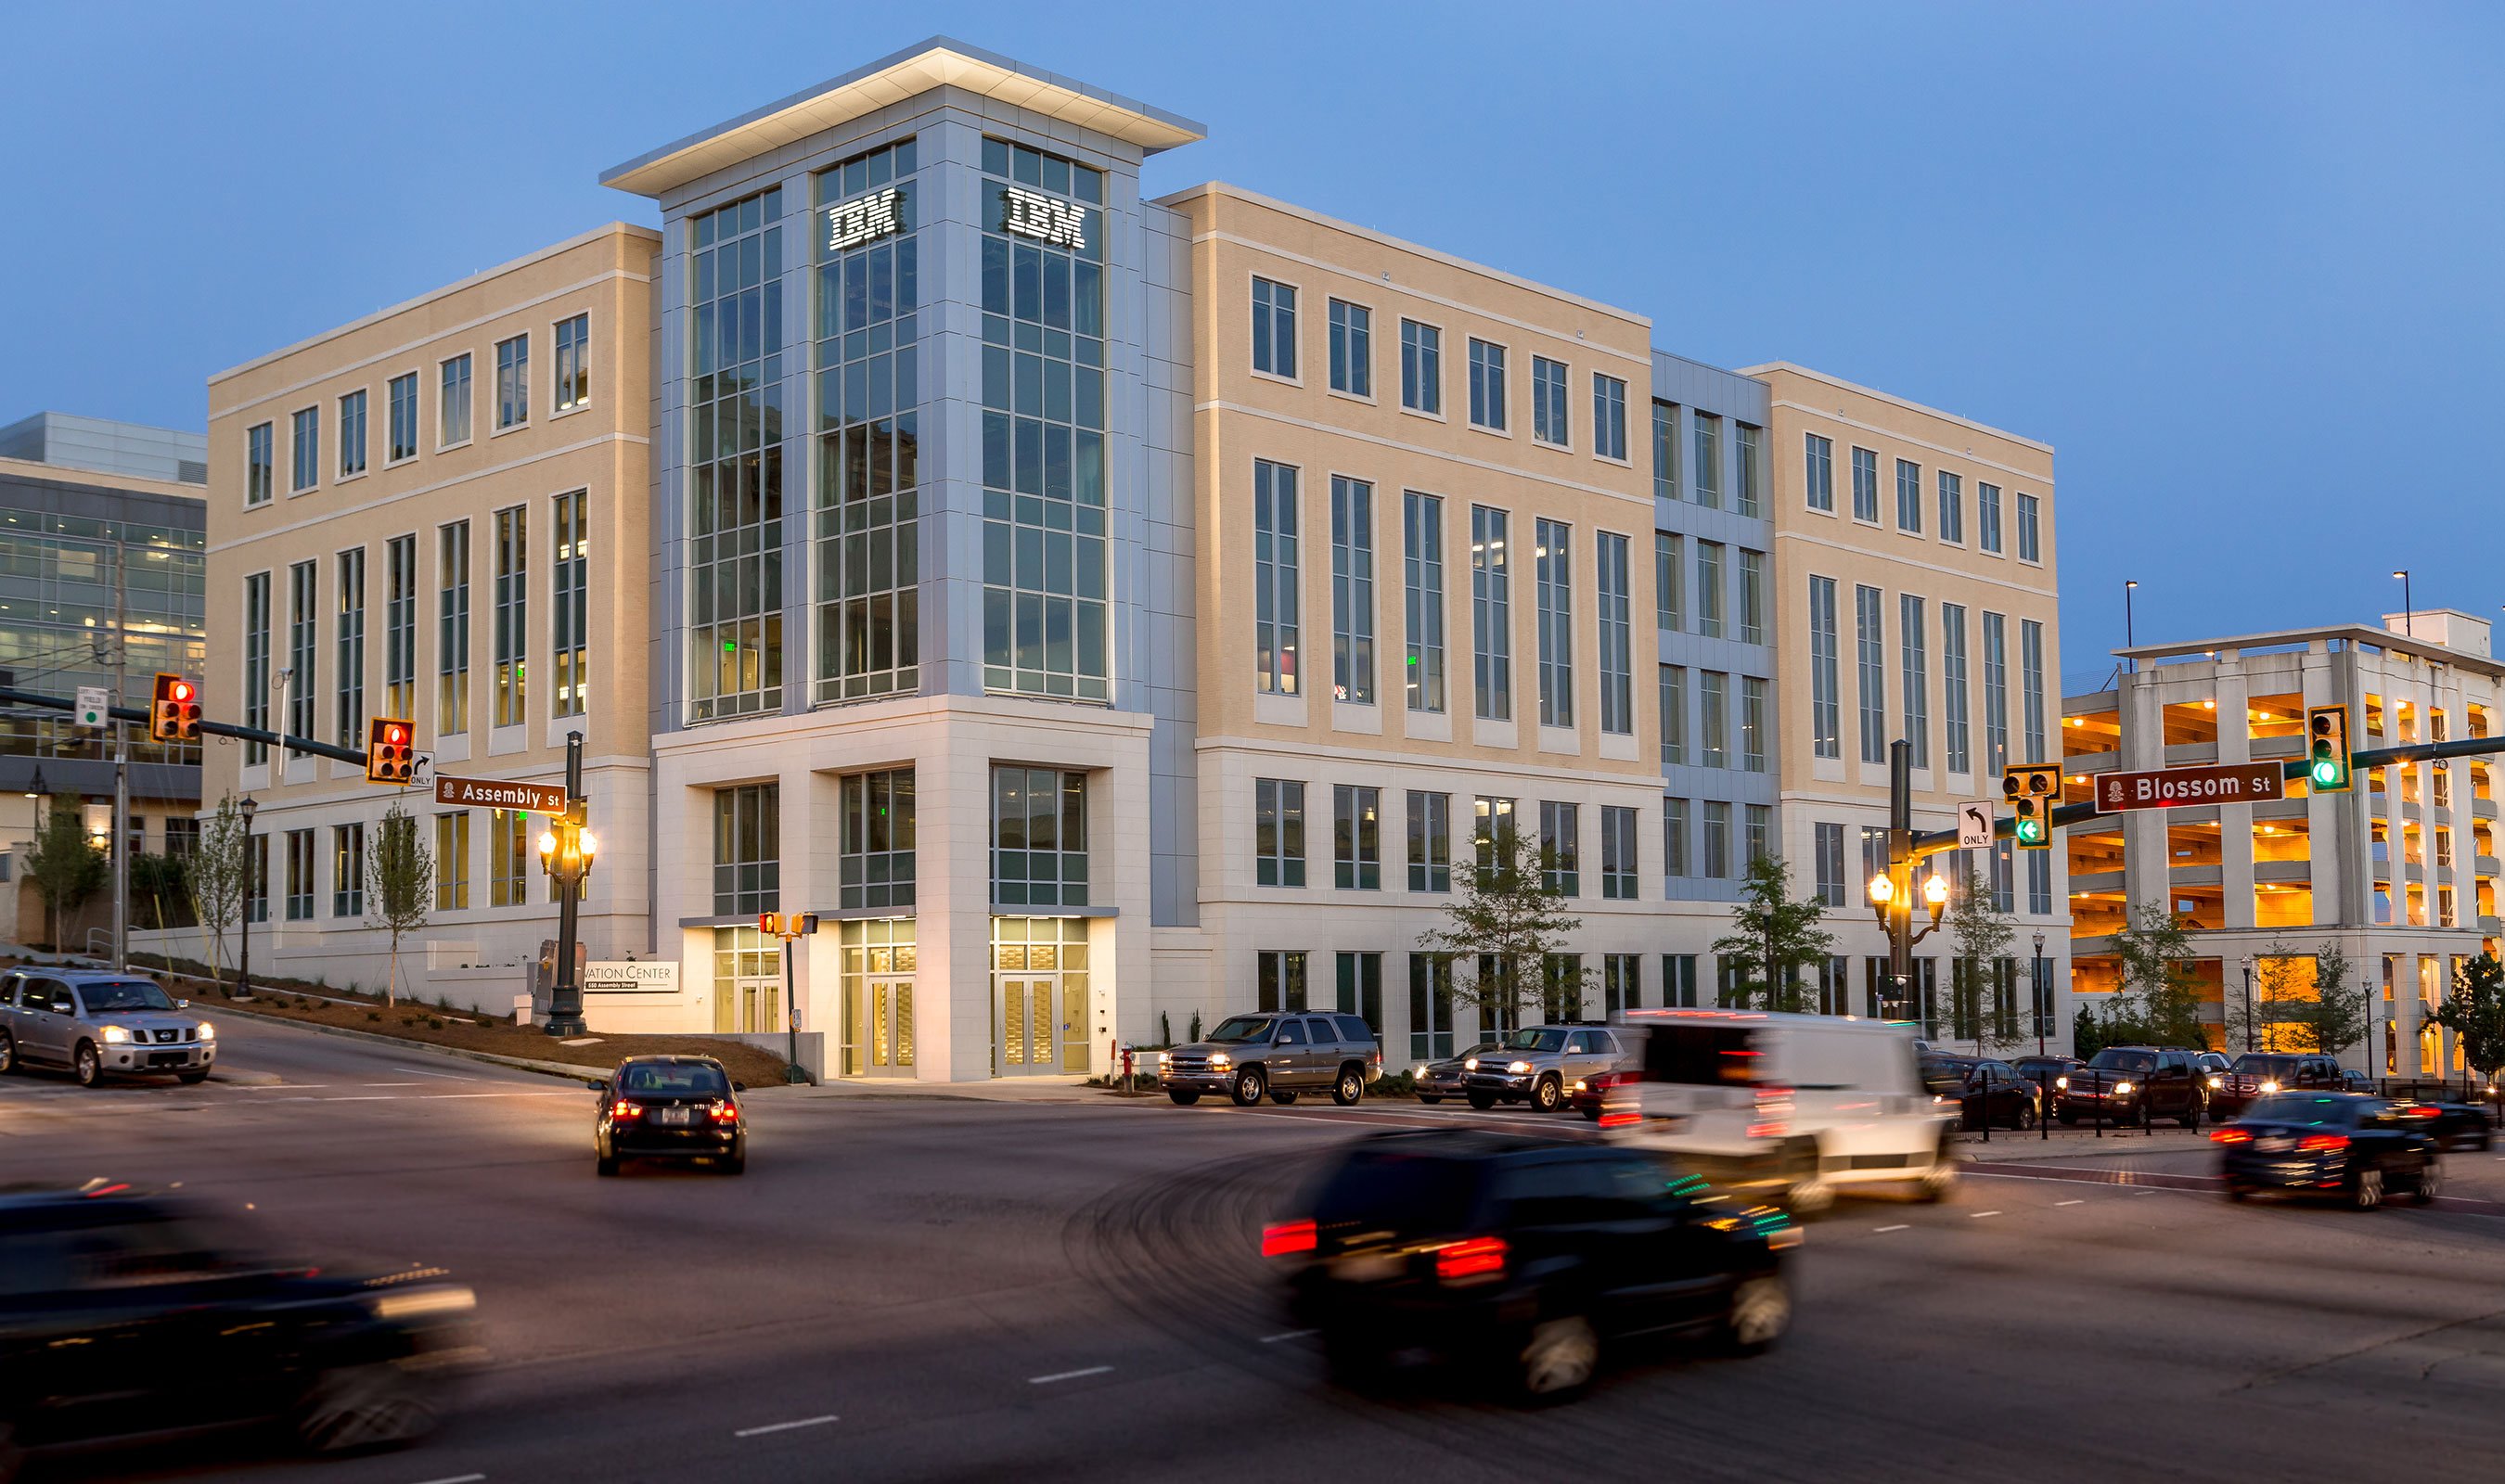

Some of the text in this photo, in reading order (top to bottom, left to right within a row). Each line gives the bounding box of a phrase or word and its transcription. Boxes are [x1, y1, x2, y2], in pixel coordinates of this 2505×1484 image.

[829, 187, 896, 251] IBM
[1008, 187, 1086, 249] IBM
[411, 776, 431, 786] ONLY
[2137, 774, 2271, 801] Blossom St
[462, 784, 559, 809] Assembly St
[1963, 834, 1990, 846] ONLY
[626, 966, 671, 979] CENTER
